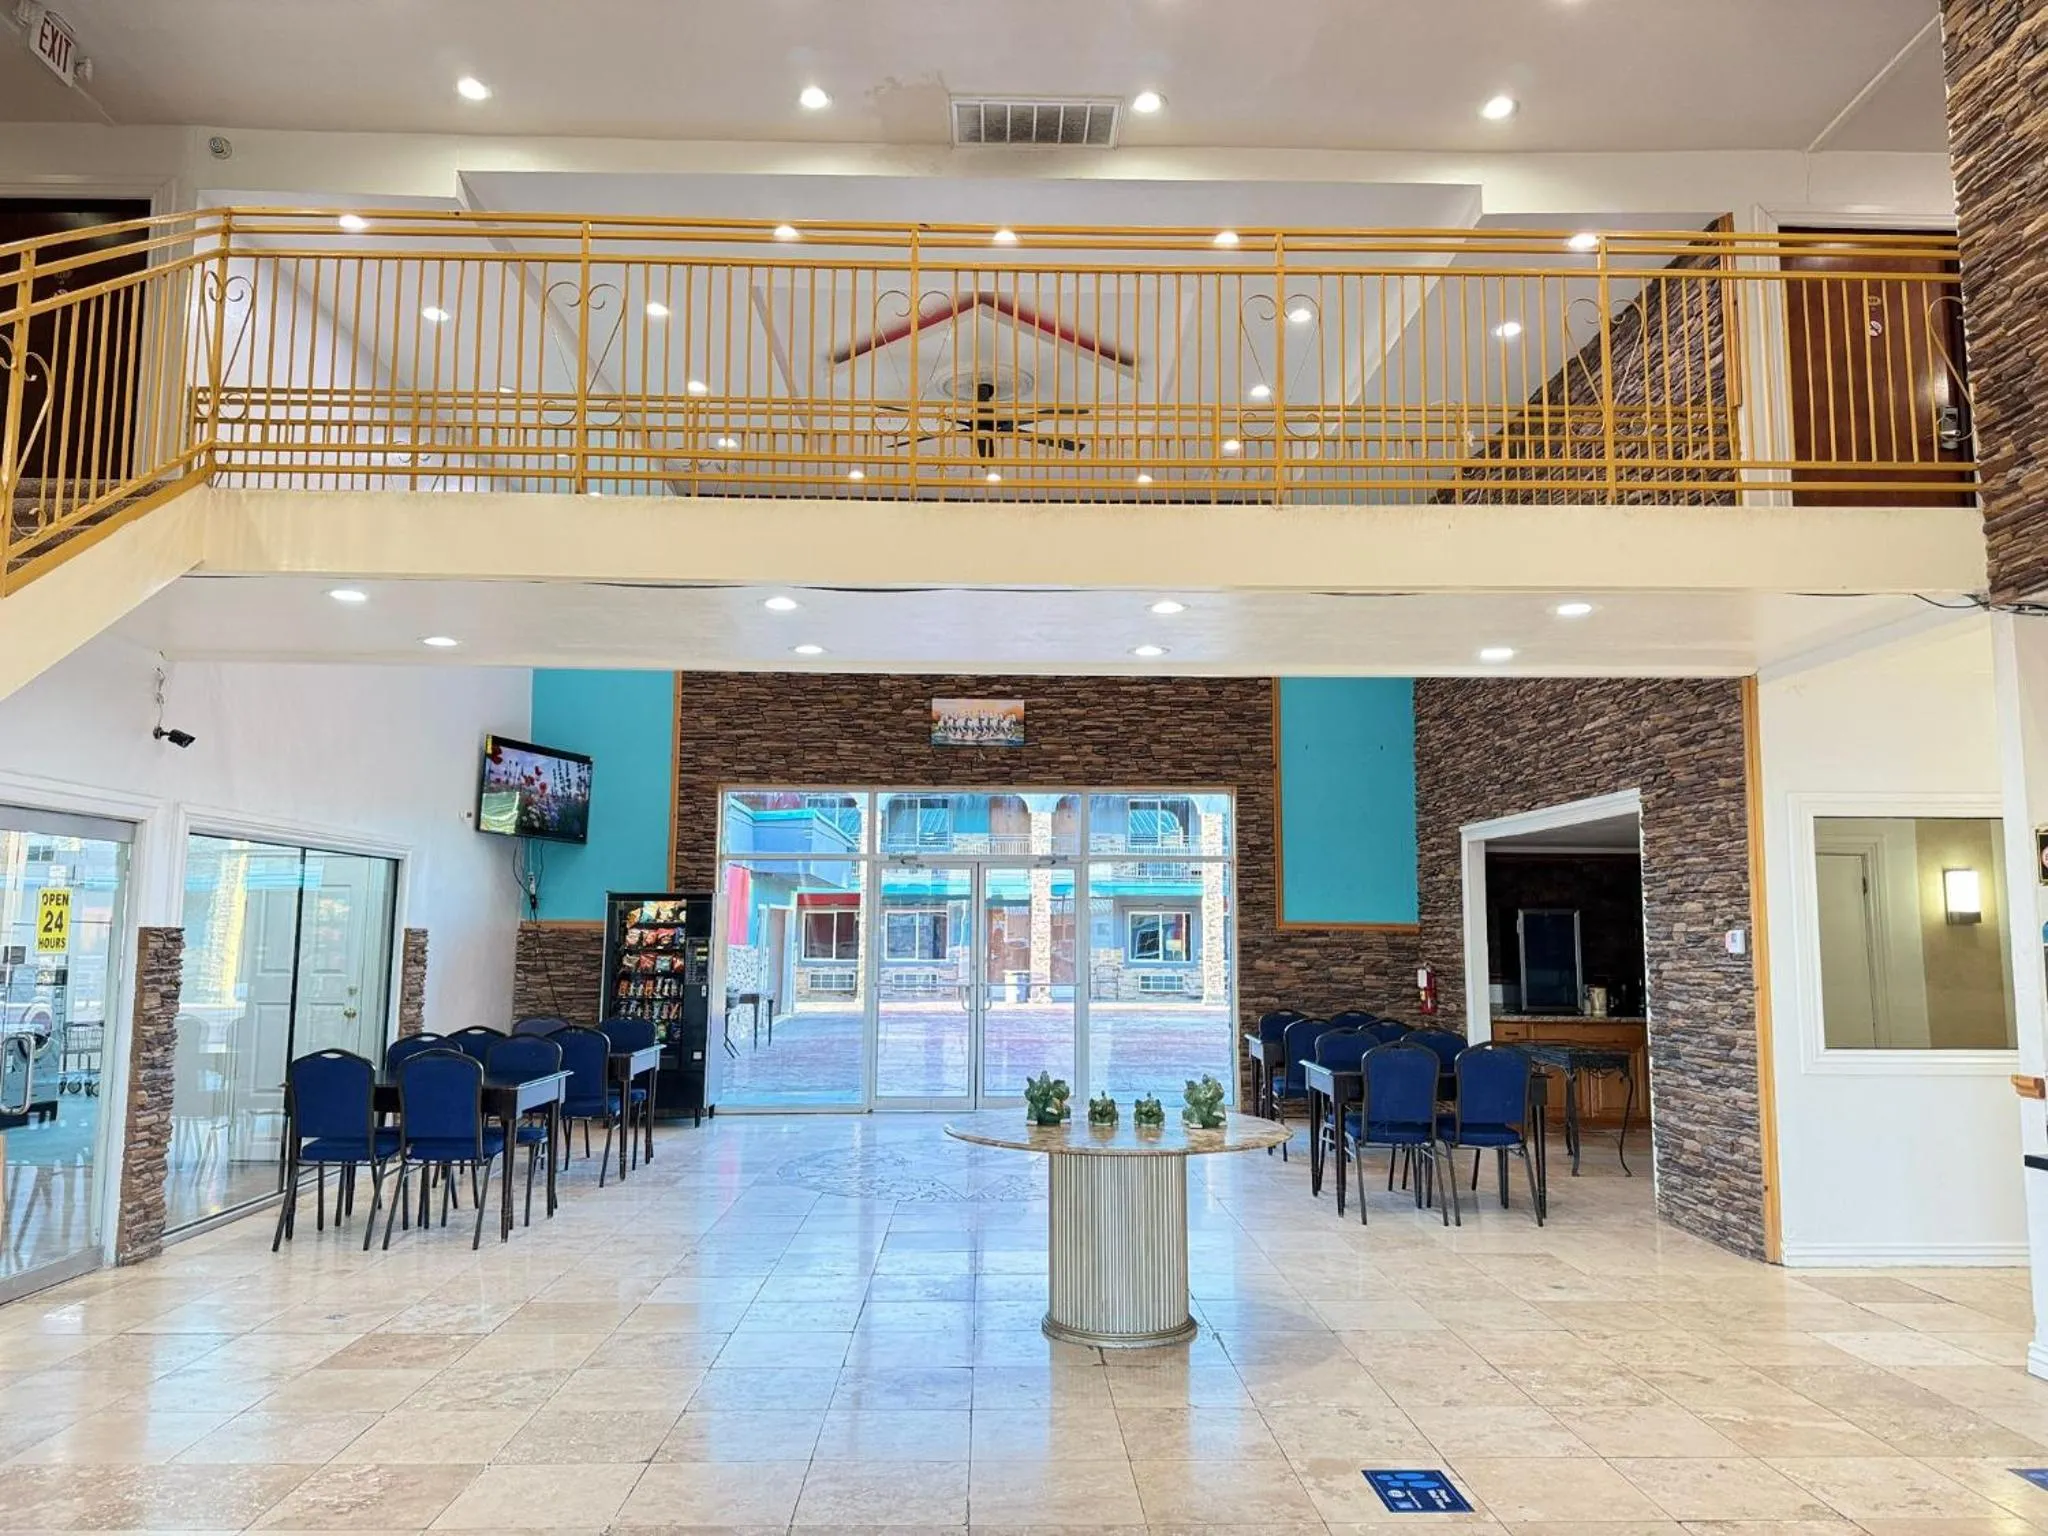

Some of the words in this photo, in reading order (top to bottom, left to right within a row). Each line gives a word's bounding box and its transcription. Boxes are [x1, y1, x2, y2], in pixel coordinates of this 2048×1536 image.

[39, 16, 71, 73] EXIT
[42, 893, 69, 906] OPEN
[42, 910, 63, 933] 24
[38, 938, 66, 949] HOURS
